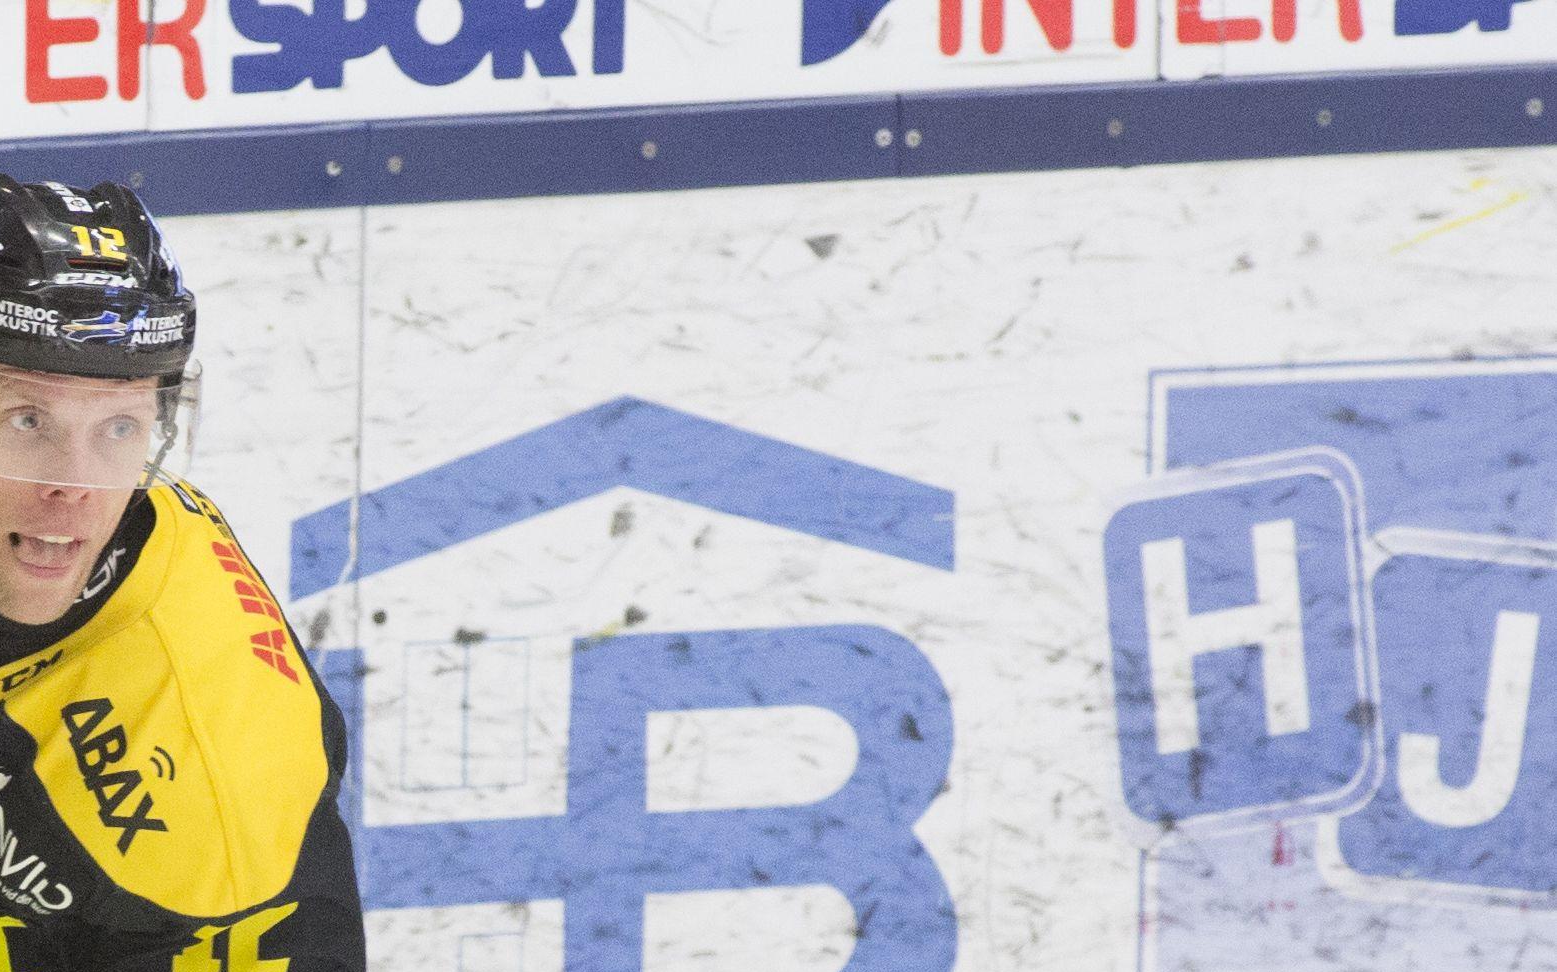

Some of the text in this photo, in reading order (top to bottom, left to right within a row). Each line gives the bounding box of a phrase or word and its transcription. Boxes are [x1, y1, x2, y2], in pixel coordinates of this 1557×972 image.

[71, 226, 128, 262] 12
[54, 272, 140, 289] CCM
[133, 312, 186, 331] INTEROC
[130, 327, 185, 344] AKUSTIK
[61, 697, 169, 857] ABAX
